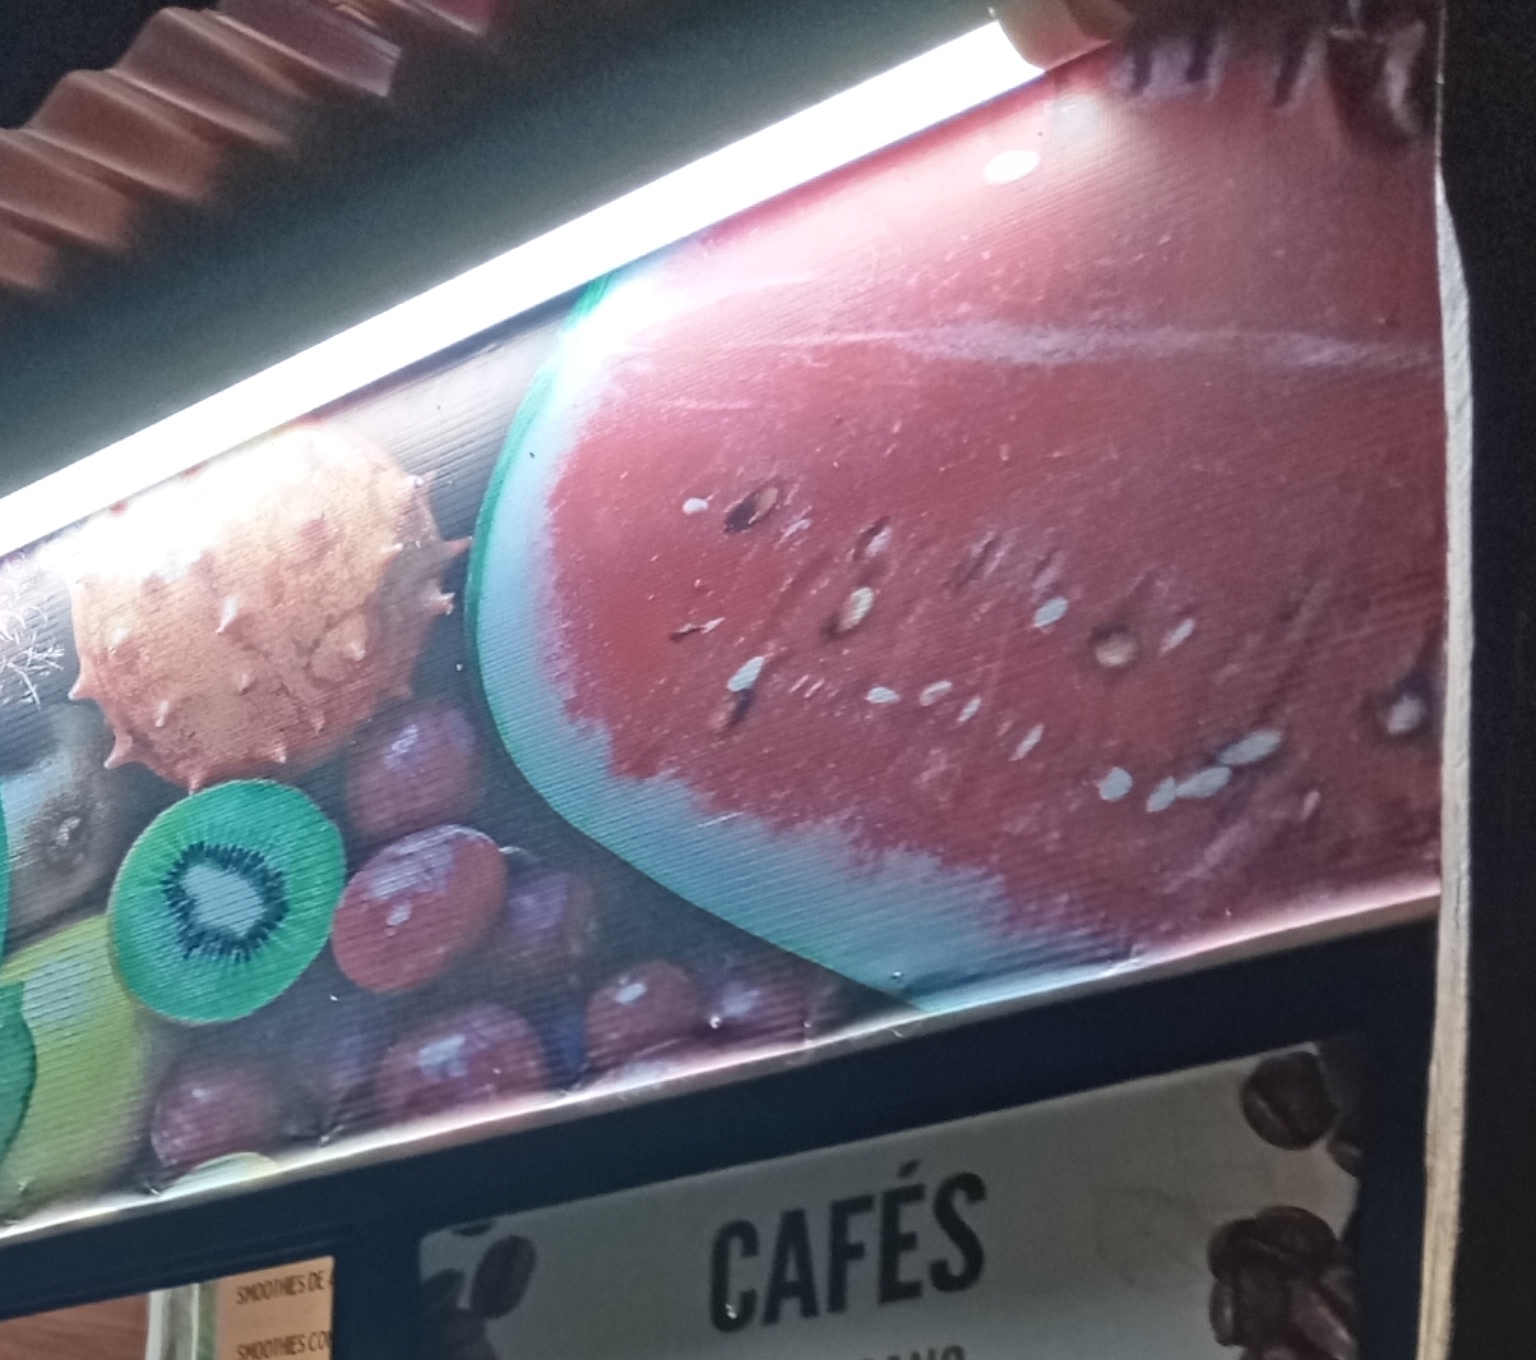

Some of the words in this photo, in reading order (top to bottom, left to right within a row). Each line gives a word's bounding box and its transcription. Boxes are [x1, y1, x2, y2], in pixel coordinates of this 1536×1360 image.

[236, 1274, 305, 1305] SMOOTHIES
[308, 1270, 324, 1292] DE
[709, 1159, 987, 1332] CAFÉS
